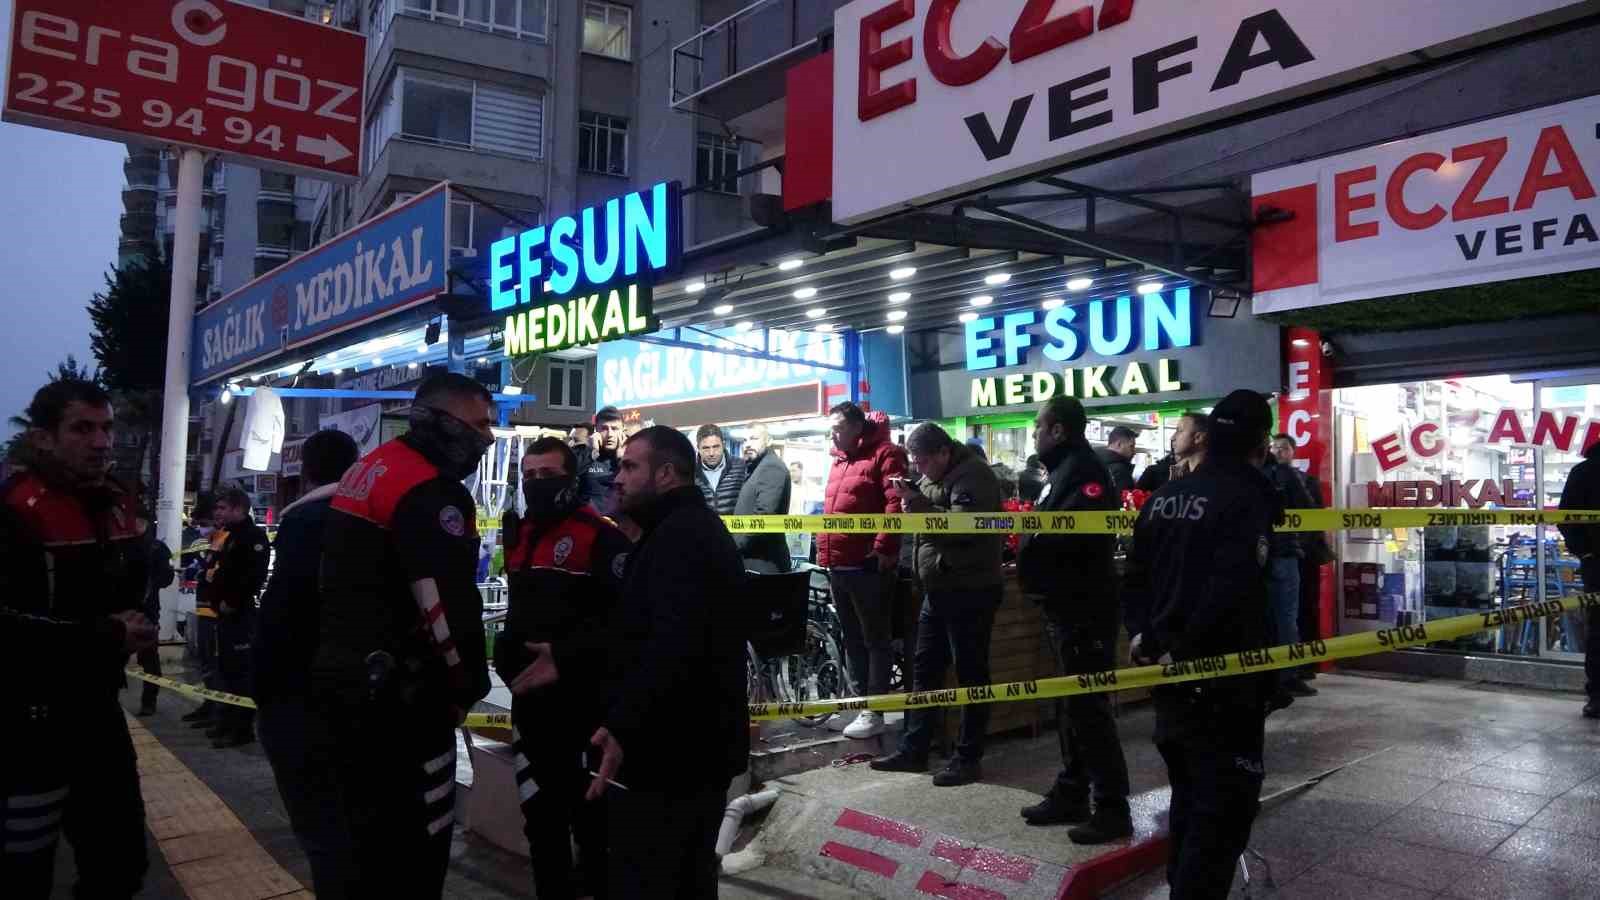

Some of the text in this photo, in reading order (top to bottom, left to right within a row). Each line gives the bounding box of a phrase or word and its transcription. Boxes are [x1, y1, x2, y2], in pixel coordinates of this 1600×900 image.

[15, 72, 285, 152] 225 94 94
[20, 10, 359, 123] era göz
[964, 8, 1315, 161] VEFA
[1334, 124, 1597, 243] ECZA
[1455, 213, 1600, 261] VEFA
[202, 226, 433, 369] SAĞLIK MEDİKAL
[489, 181, 667, 312] EFSUN
[965, 286, 1191, 372] EFSUN
